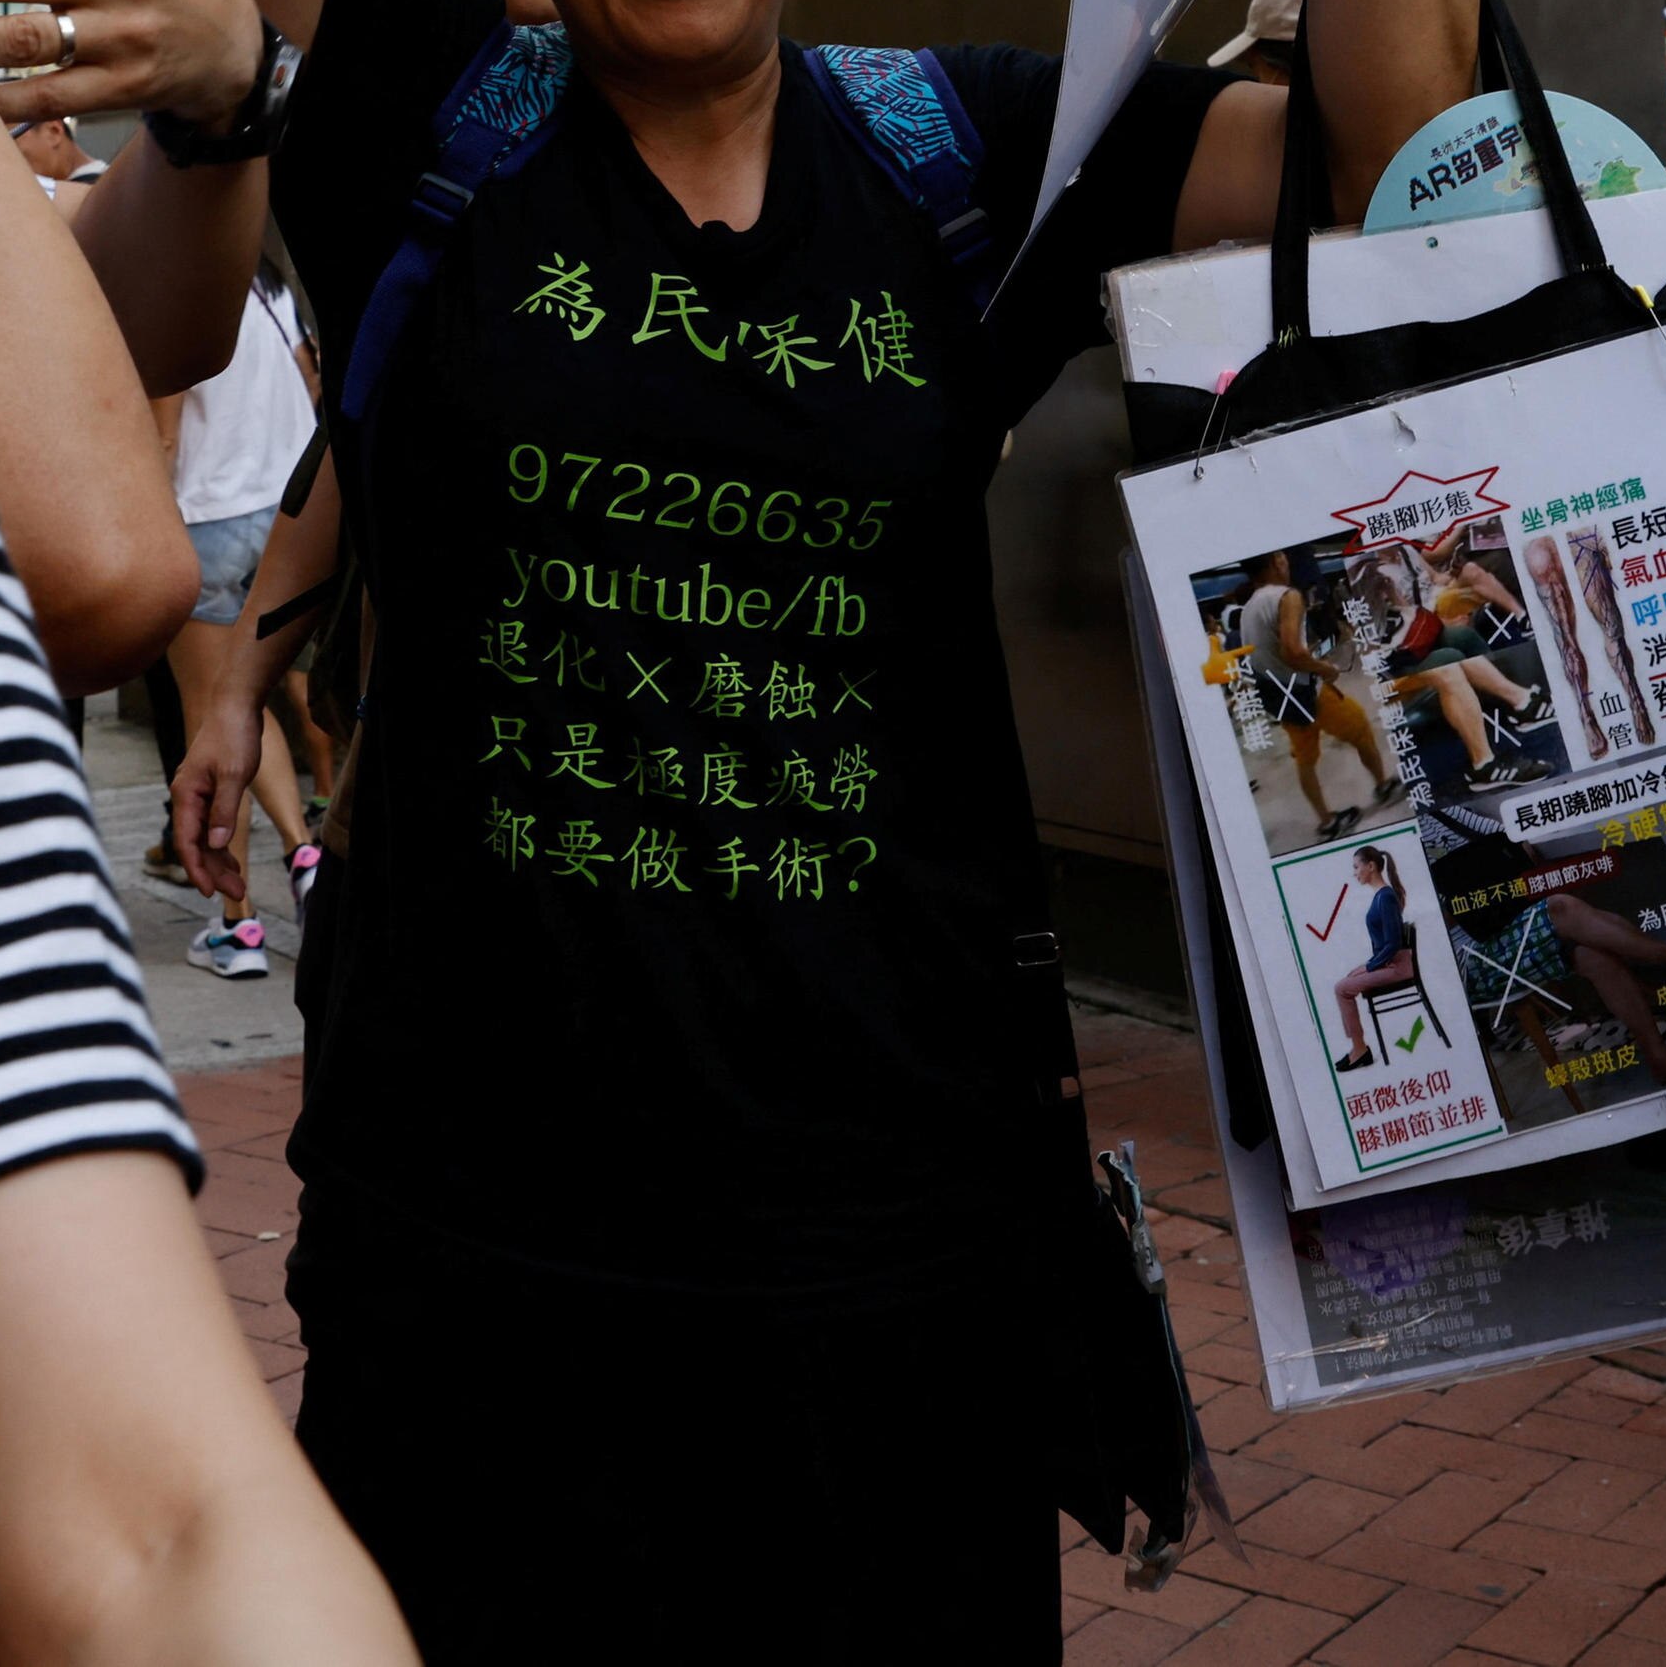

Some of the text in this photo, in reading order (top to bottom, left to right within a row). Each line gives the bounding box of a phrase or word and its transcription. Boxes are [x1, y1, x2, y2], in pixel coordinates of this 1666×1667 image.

[512, 251, 928, 389] 為民保健
[507, 443, 893, 550] 97226635
[1366, 489, 1474, 541] 蹺腳形態
[1520, 476, 1648, 534] 坐骨神經痛
[501, 545, 867, 637] youtube/fb
[1599, 690, 1634, 752] 血管
[478, 715, 879, 814] 只是極度疲勞
[1449, 878, 1529, 917] 血液不通
[1344, 1068, 1452, 1121] 頭微後仰
[1356, 1095, 1489, 1155] 膝關節並排
[1496, 1199, 1611, 1257] 推拿後
